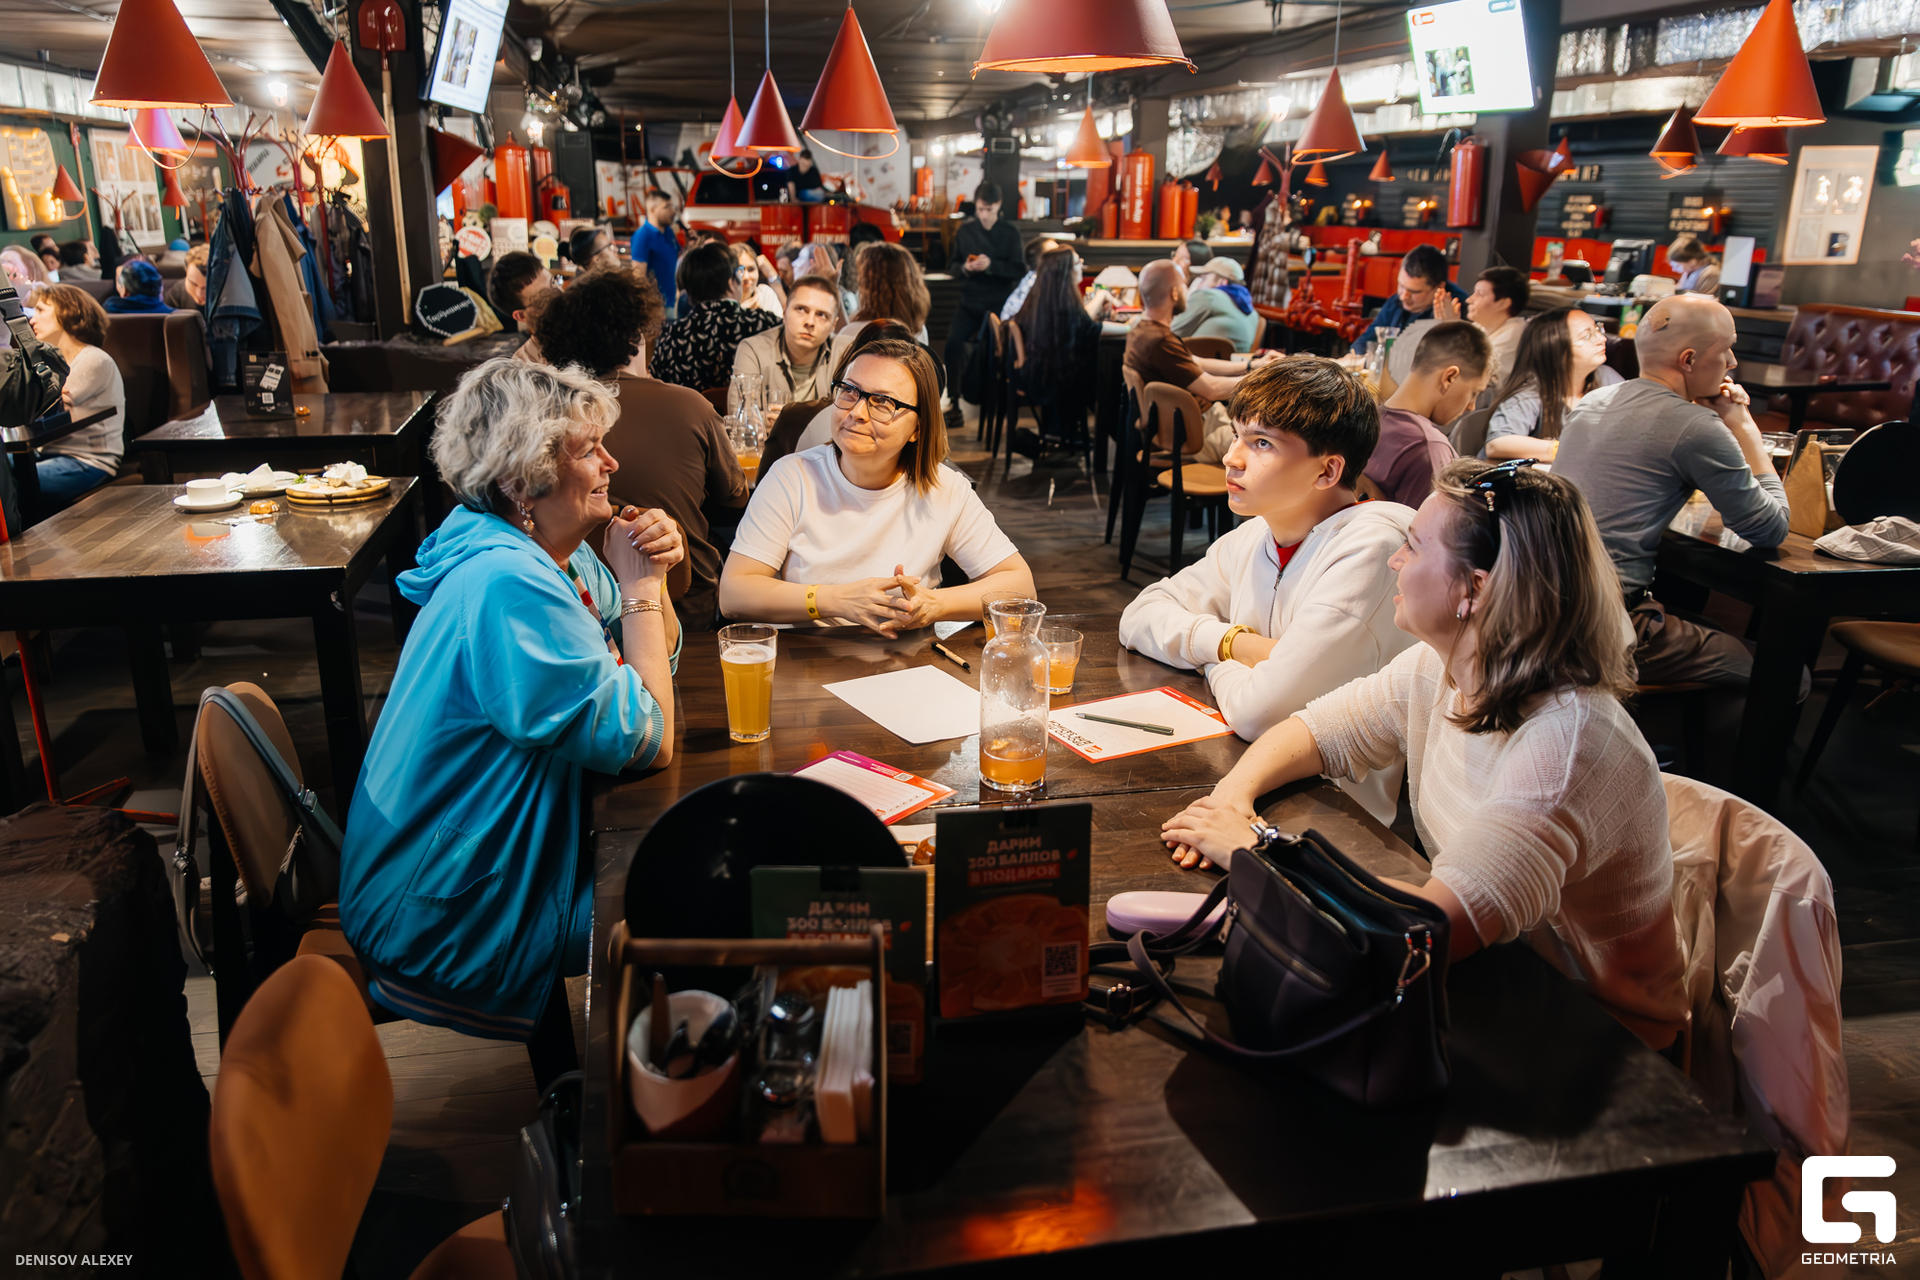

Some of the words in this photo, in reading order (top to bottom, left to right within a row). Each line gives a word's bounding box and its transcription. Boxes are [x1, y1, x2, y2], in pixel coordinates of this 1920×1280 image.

[986, 836, 1042, 854] ДАРИМ
[967, 856, 996, 869] 300
[999, 849, 1061, 867] БАЛЛОВ
[971, 872, 980, 884] В
[983, 865, 1057, 882] ПОДАРОК
[787, 917, 819, 931] 300
